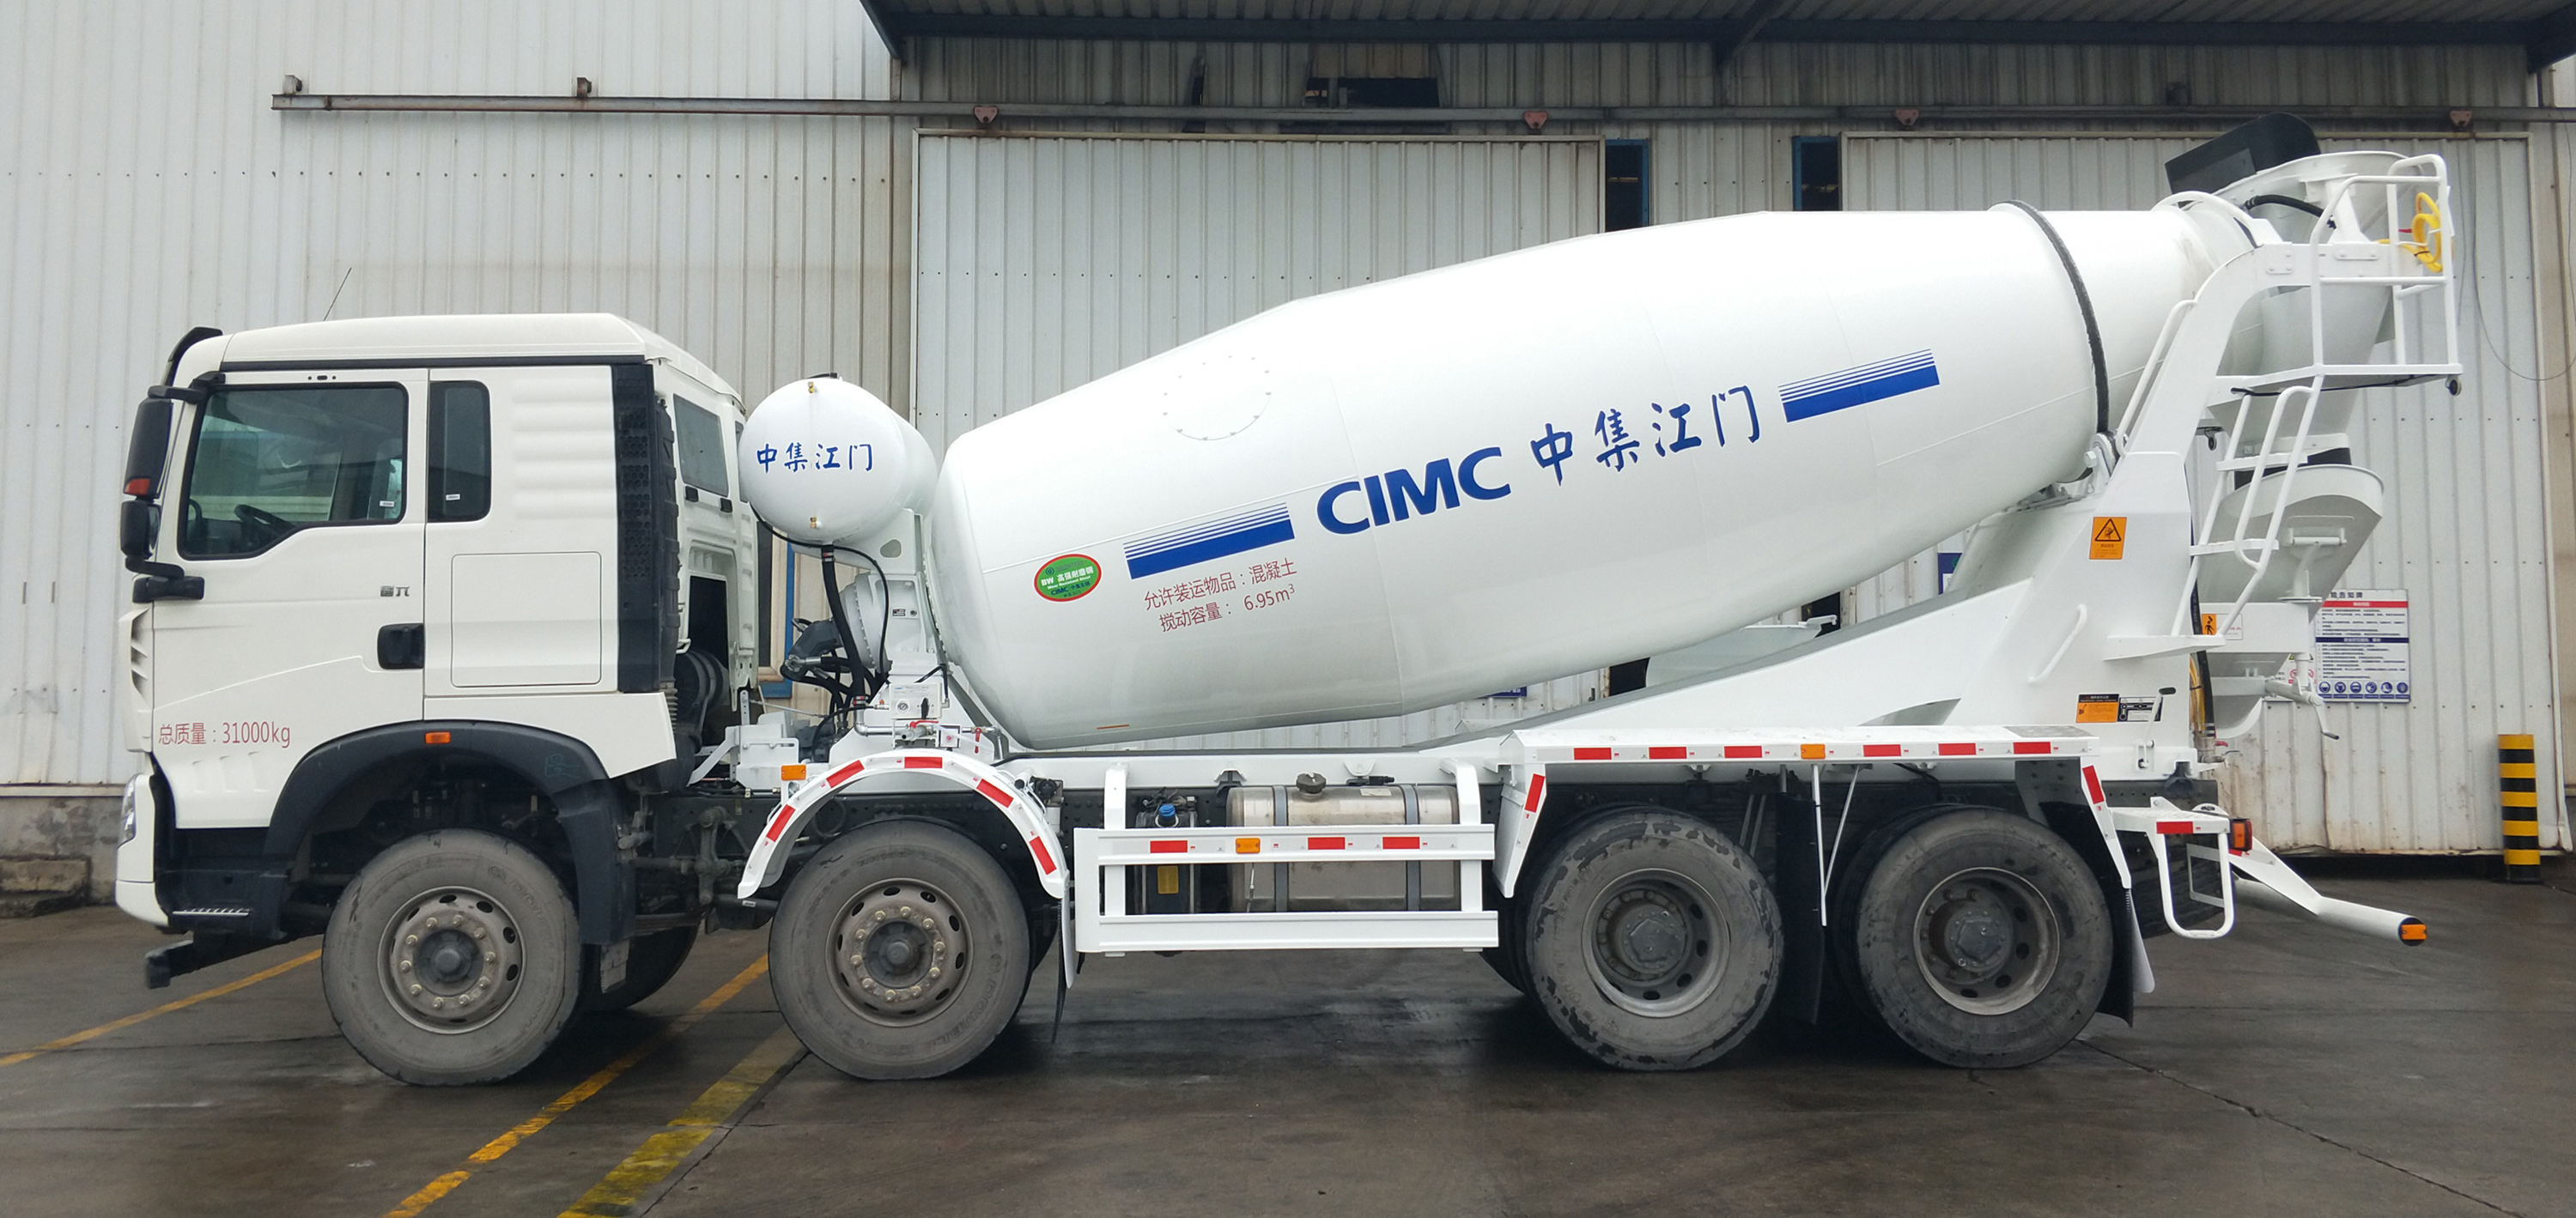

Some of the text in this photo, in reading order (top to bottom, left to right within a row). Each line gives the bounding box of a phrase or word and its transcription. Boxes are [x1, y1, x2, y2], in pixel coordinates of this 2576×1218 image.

[756, 442, 873, 474] 中集江门
[1530, 385, 1760, 487] 中集江门
[1316, 446, 1511, 535] CIMC
[1041, 577, 1054, 586] BW
